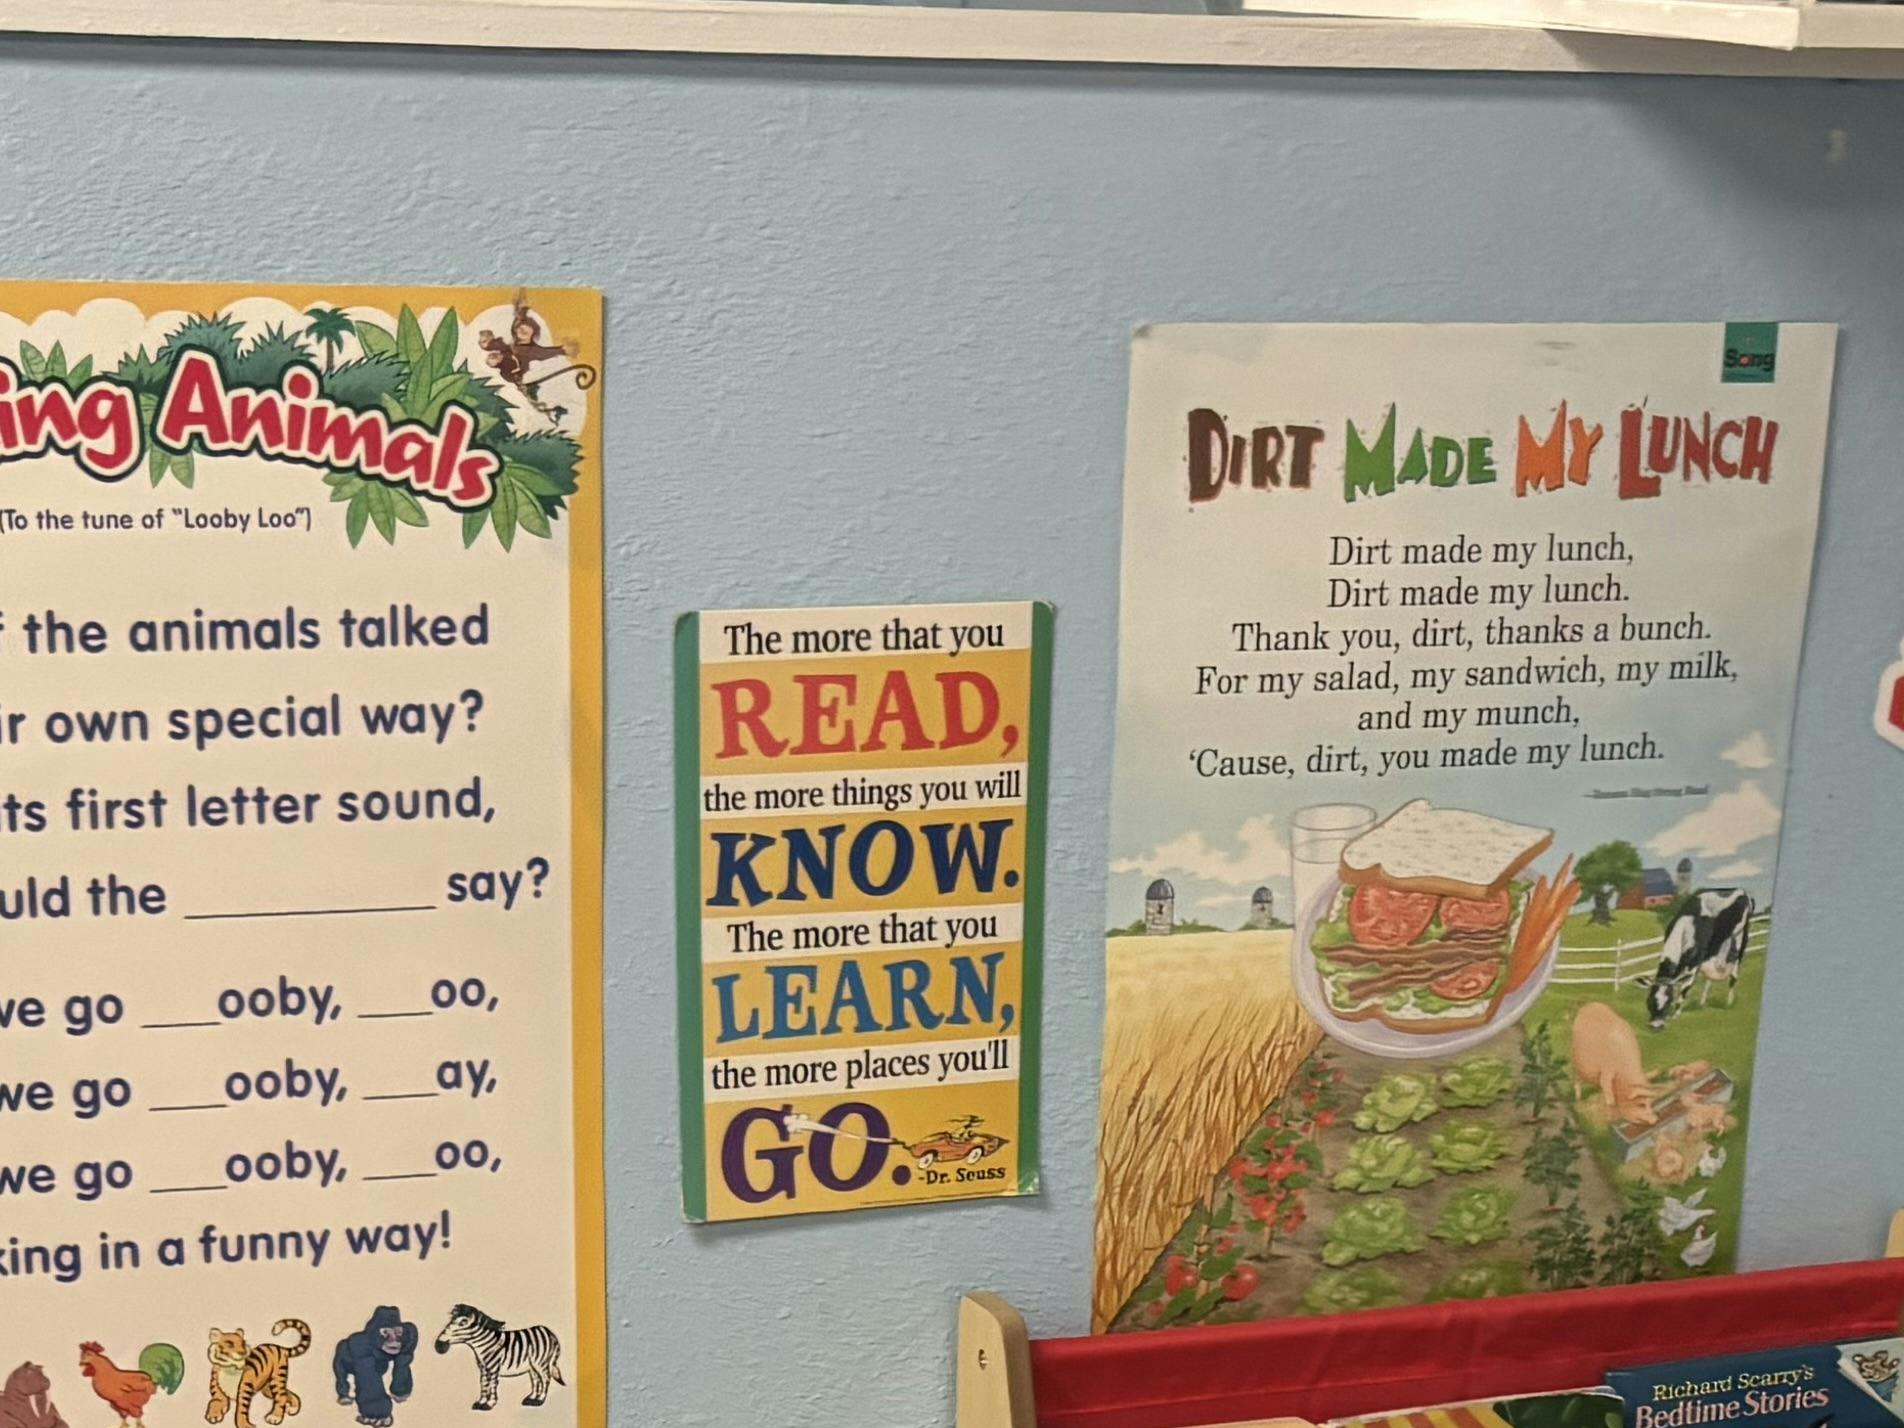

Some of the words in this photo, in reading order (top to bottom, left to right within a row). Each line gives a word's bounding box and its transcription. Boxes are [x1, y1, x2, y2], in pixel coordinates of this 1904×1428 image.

[159, 354, 500, 505] Animals
[37, 509, 73, 530] the
[82, 510, 133, 529] tune
[141, 509, 164, 529] of
[1329, 536, 1392, 567] Dirt
[1403, 538, 1482, 564] made
[1492, 540, 1537, 569] my
[1546, 533, 1634, 566] lunch,
[24, 608, 107, 654] the
[128, 605, 320, 652] animals
[340, 604, 488, 648] talked
[724, 624, 782, 656] The
[792, 627, 872, 653] more
[881, 619, 942, 651] that
[950, 621, 1004, 653] you
[1232, 622, 1329, 652] Thank
[1341, 626, 1400, 656] you,
[1412, 619, 1473, 652] dirt,
[1485, 616, 1584, 647] thanks
[1594, 624, 1609, 644] a
[1620, 612, 1711, 642] bunch.
[1195, 666, 1250, 695] For
[1258, 671, 1302, 700] my
[1314, 661, 1400, 694] salad,
[1411, 666, 1455, 694] my
[1465, 655, 1606, 690] sandwich,
[1616, 659, 1658, 687] my
[1668, 652, 1738, 682] milk,
[45, 707, 148, 742] own
[169, 694, 340, 751] special
[361, 688, 484, 743] way?
[710, 669, 1020, 761] READ,
[67, 788, 167, 830] first
[187, 783, 320, 827] letter
[338, 777, 497, 824] sound,
[703, 784, 746, 812] the
[754, 783, 825, 809] more
[832, 777, 912, 811] things
[919, 779, 967, 808] you
[976, 771, 1021, 801] will
[87, 876, 166, 917] the
[447, 857, 550, 910] say?
[706, 819, 1020, 907] KNOW.
[710, 951, 1015, 1044] LEARN,
[712, 1060, 756, 1090] the
[763, 1059, 839, 1085] more
[847, 1053, 929, 1088] places
[938, 1041, 1010, 1078] you'll
[721, 1102, 912, 1204] GO.
[918, 1168, 952, 1186] -Dr.
[956, 1165, 1007, 1183] Seuss
[100, 1232, 141, 1270] in
[157, 1235, 184, 1267] a
[199, 1223, 330, 1269] funny
[347, 1210, 452, 1260] way!
[1652, 1375, 1733, 1402] Richard
[1737, 1364, 1815, 1389] Scarry's
[1742, 1385, 1830, 1418] Stories
